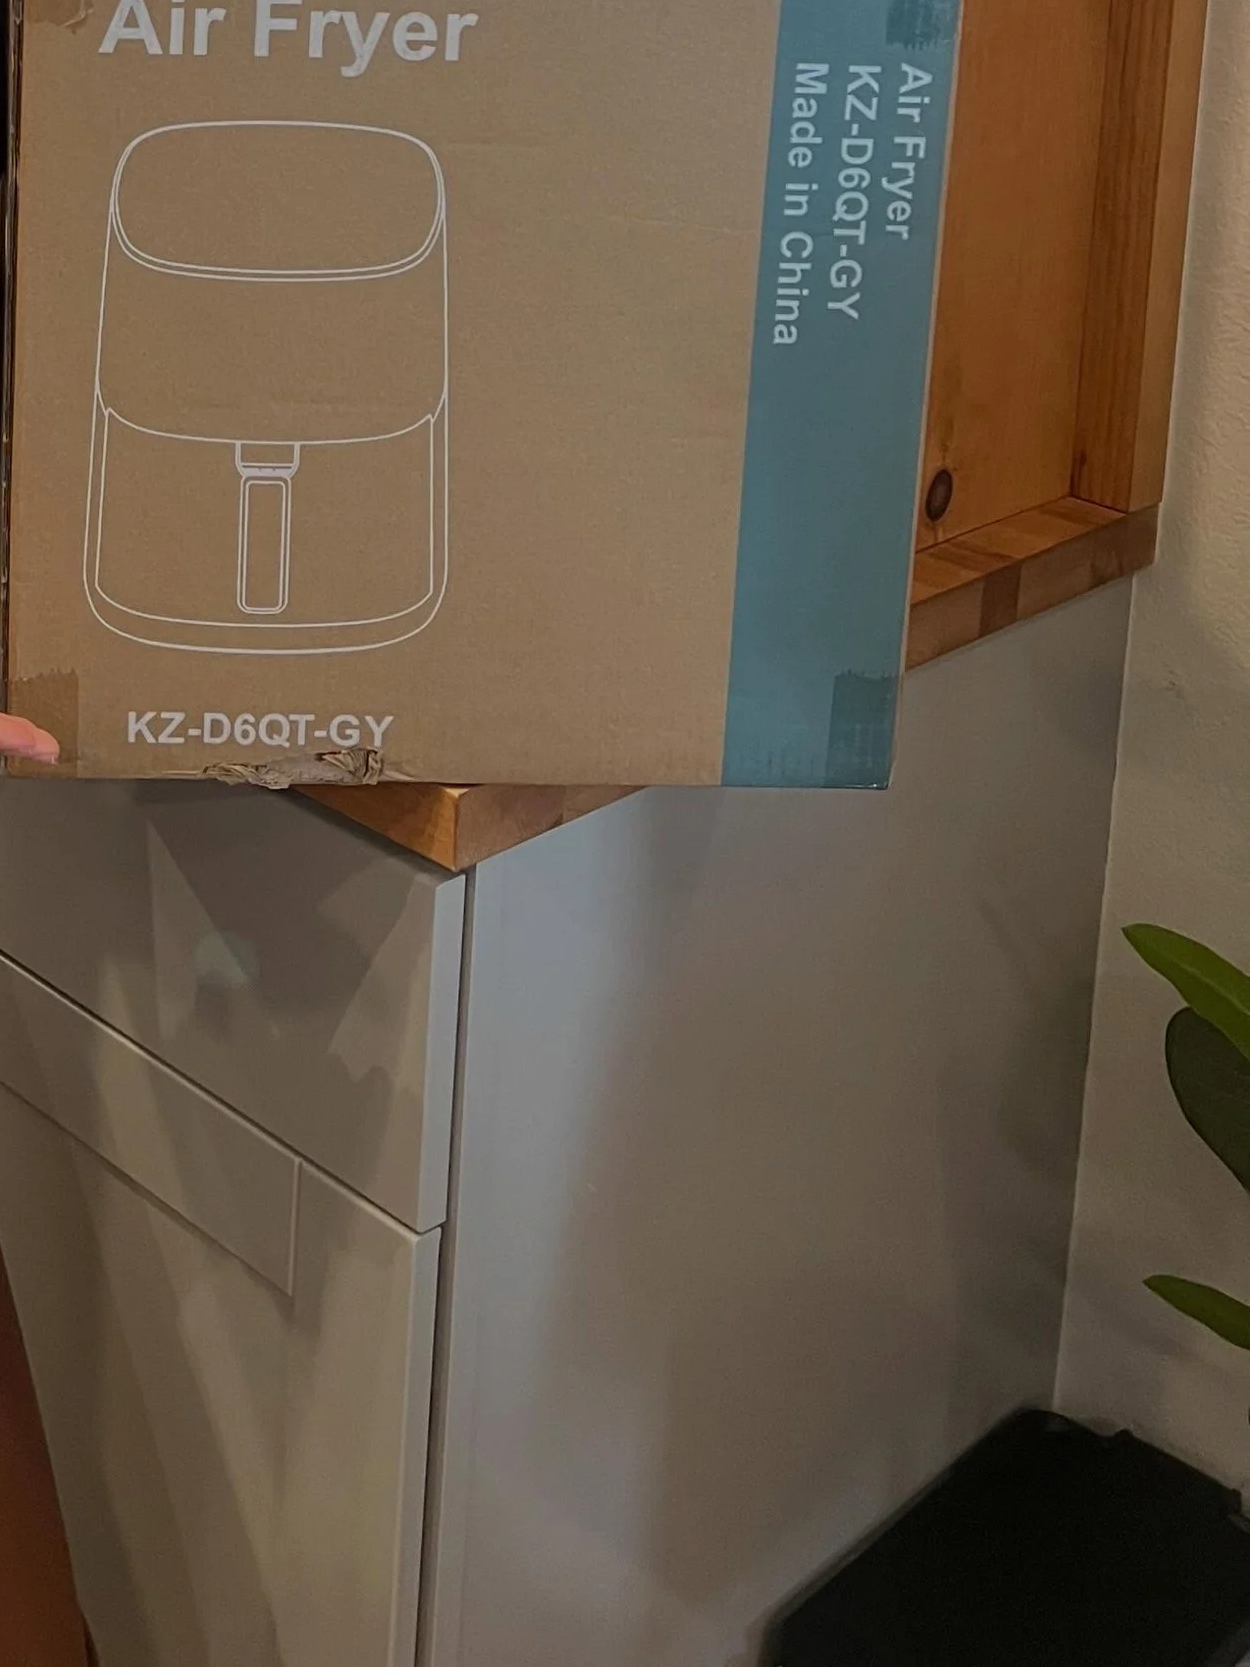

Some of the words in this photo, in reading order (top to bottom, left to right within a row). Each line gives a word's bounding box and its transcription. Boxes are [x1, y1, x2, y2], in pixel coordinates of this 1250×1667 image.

[787, 62, 830, 168] Made
[896, 62, 933, 123] Air
[783, 182, 818, 216] in
[827, 65, 882, 320] KZ-D6QT-GY
[882, 136, 927, 241] Fryer
[772, 231, 814, 345] China
[127, 711, 394, 748] KZ-D6QT-GY
